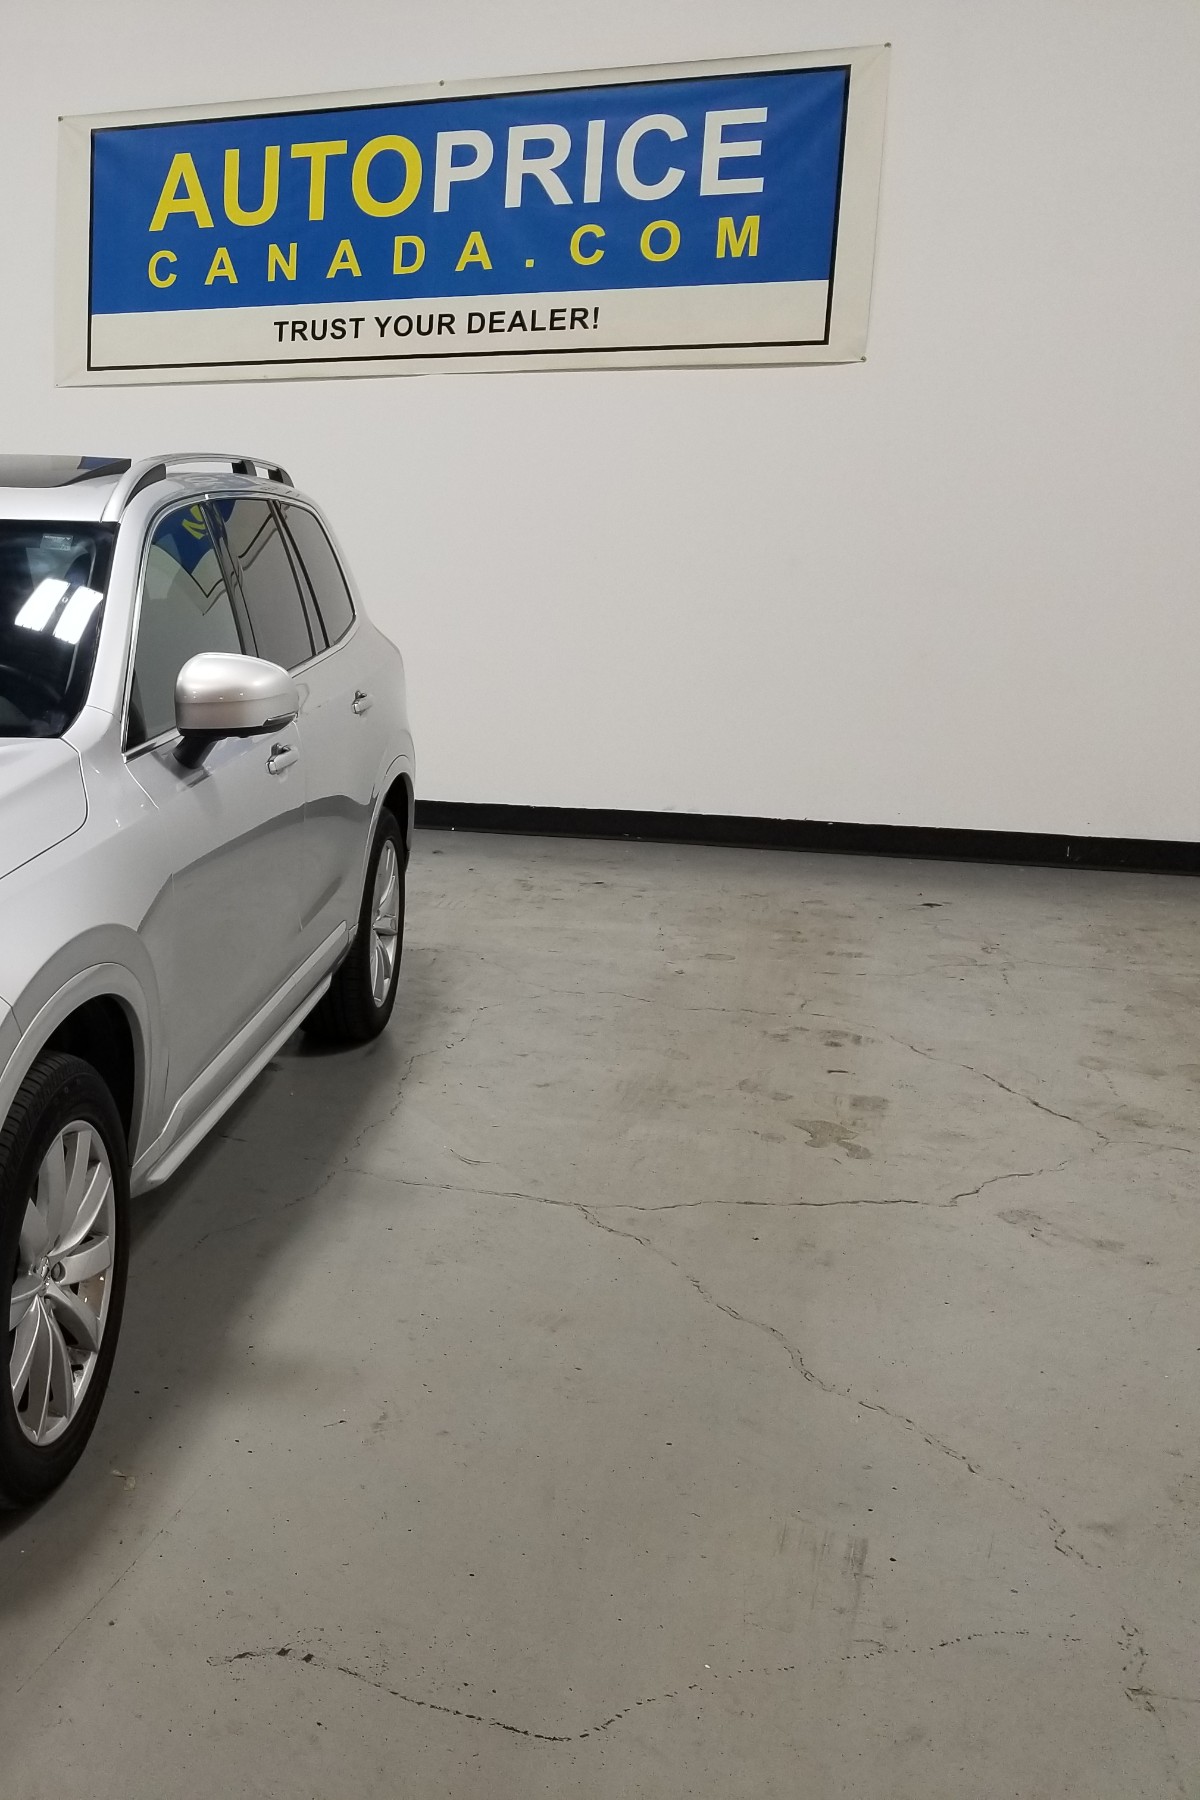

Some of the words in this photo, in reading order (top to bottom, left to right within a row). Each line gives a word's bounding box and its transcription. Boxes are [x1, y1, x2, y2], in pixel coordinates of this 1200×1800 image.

[149, 107, 768, 232] AUTOPRICE
[273, 317, 366, 343] TRUST
[374, 313, 456, 338] YOUR
[467, 307, 600, 335] DEALER!
